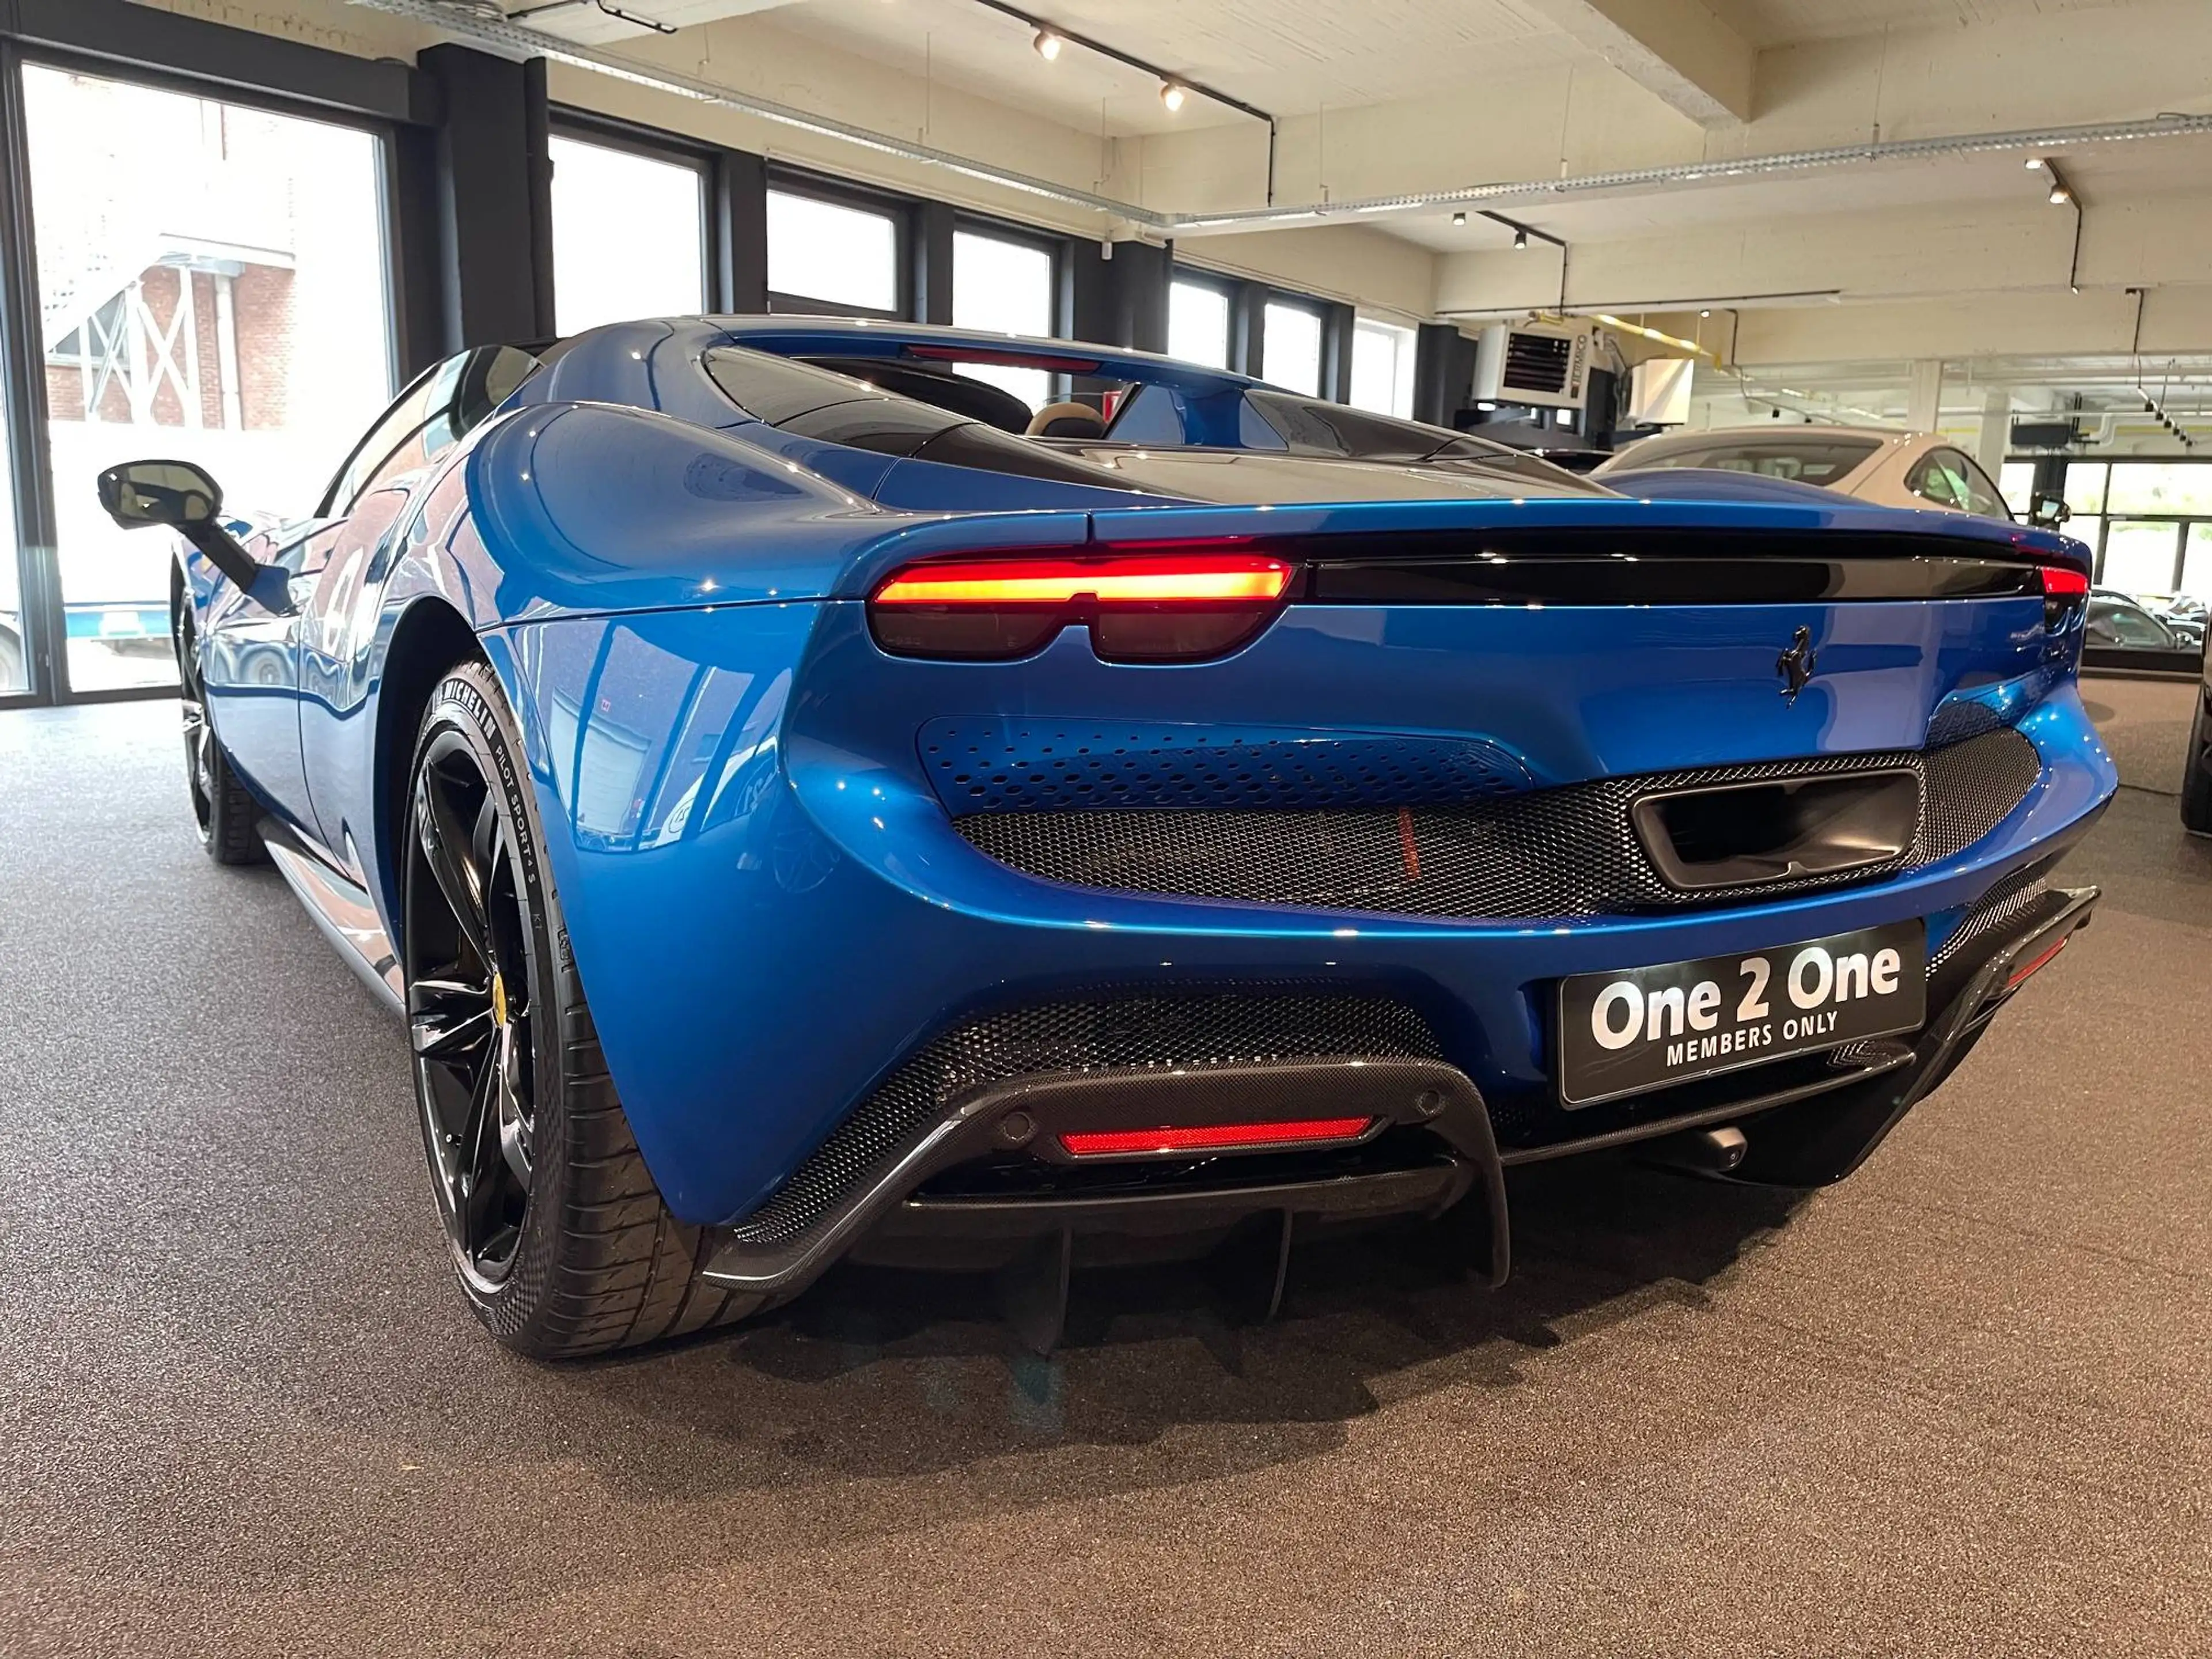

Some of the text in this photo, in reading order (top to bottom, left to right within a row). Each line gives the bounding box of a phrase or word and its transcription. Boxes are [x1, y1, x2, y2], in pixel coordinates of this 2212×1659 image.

[444, 681, 496, 740] MICHELIN
[495, 745, 514, 787] PILOT
[511, 794, 531, 855] SPORT
[528, 873, 536, 884] S
[1592, 946, 1900, 1050] One 2 One
[1666, 1010, 1838, 1067] MEMBERS ONLY
